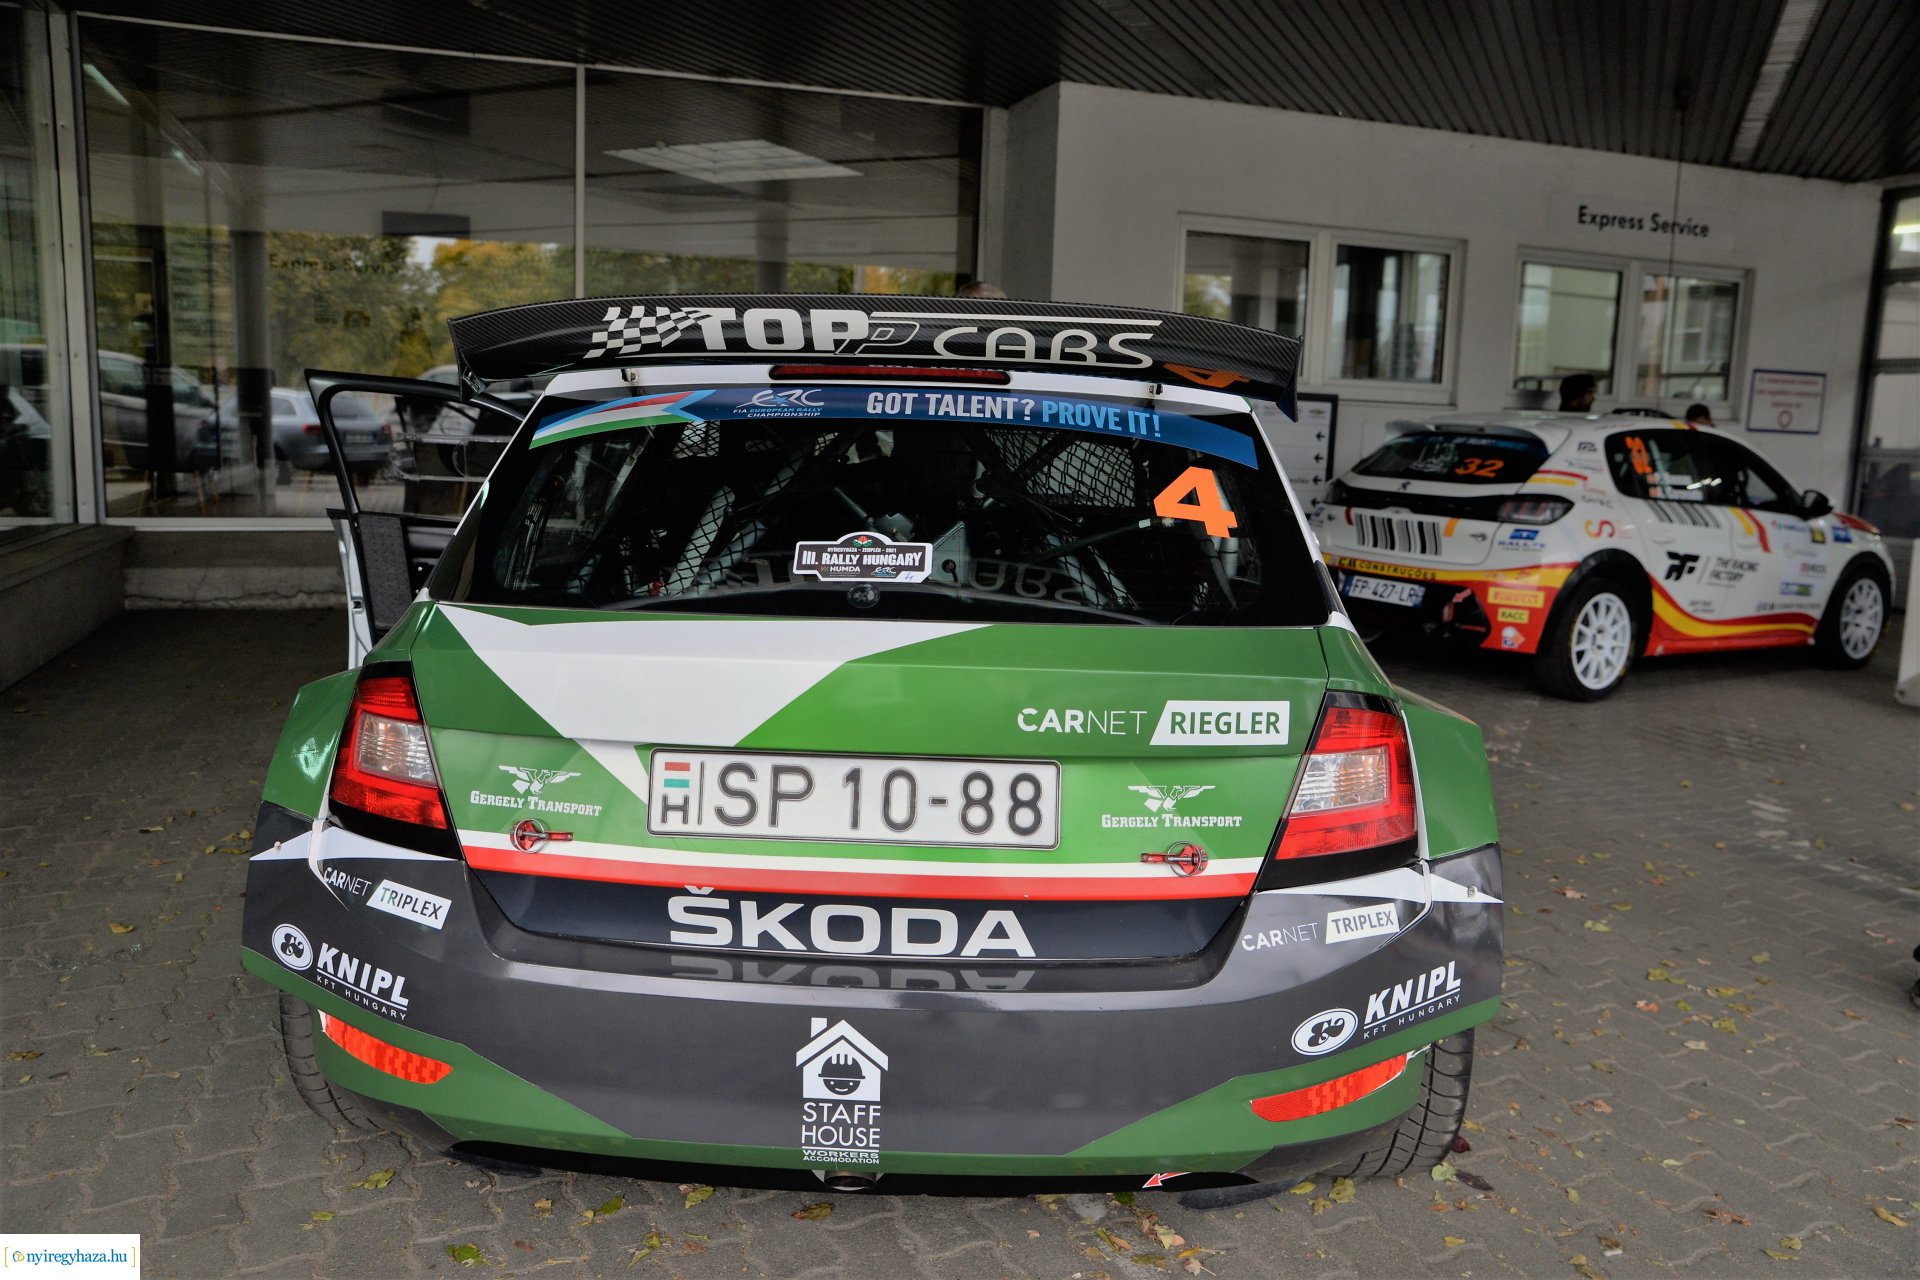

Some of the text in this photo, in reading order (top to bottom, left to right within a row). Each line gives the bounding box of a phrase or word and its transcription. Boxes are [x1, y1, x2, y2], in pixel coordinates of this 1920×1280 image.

[1578, 205, 1710, 237] Express Service
[933, 327, 1154, 368] CARS
[866, 391, 1161, 437] GOT TALENT? PROVE IT!
[1454, 458, 1504, 478] 32
[1153, 466, 1238, 539] 4
[802, 551, 923, 566] III. RALLY HUNGARY
[1017, 707, 1280, 735] CARNET RIEGLER
[470, 790, 602, 817] GERGELY TRANSPORT
[661, 793, 690, 825] H
[842, 767, 1043, 836] 10-88
[1102, 813, 1242, 828] GERGELY TRANSPORT
[324, 866, 442, 920] CARNET TRIPLEX
[668, 885, 1036, 957] ŠKODA
[1241, 910, 1395, 951] CARNET TRIPLEX
[317, 942, 409, 1006] KNIPL
[1364, 960, 1461, 1025] KNIPL
[316, 974, 407, 1021] KFT HUNGARY
[1363, 994, 1461, 1039] KFT HUNGARY
[802, 1102, 881, 1125] STAFF
[801, 1124, 880, 1148] HOUSE
[802, 1149, 879, 1159] WORKERS
[803, 1155, 880, 1164] ACCOMODATION
